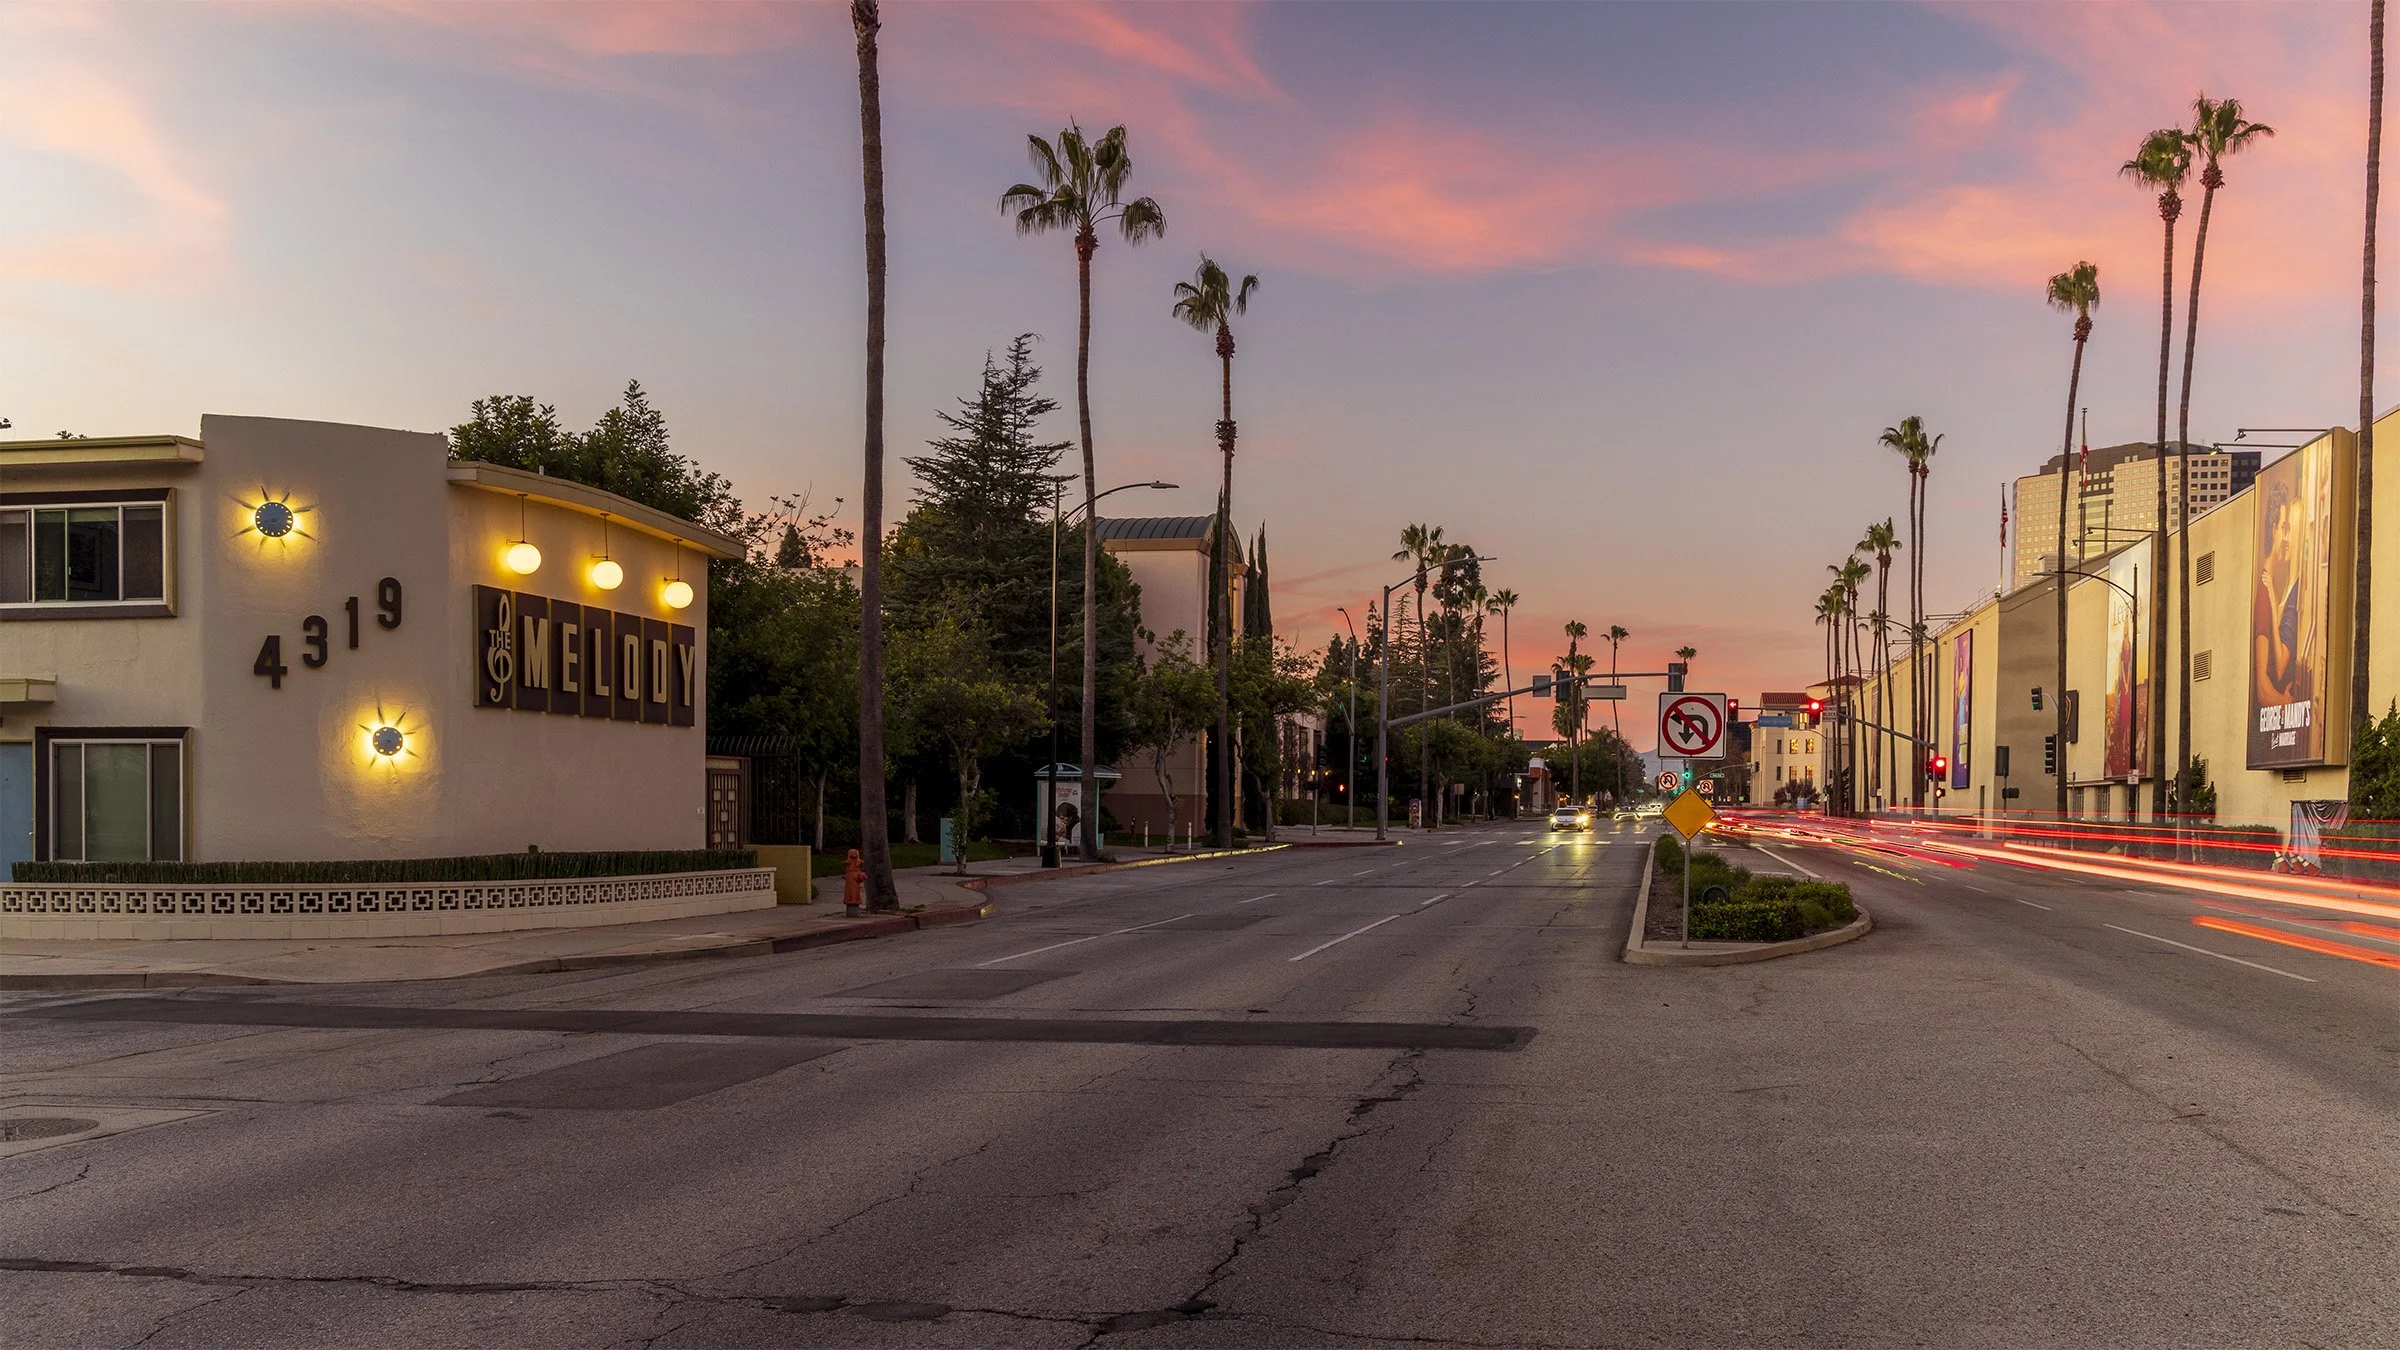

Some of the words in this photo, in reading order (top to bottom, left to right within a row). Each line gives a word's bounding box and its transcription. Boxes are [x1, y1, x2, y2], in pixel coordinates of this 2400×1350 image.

[253, 576, 402, 690] 4319
[489, 629, 511, 649] THE
[523, 614, 695, 706] MELODY
